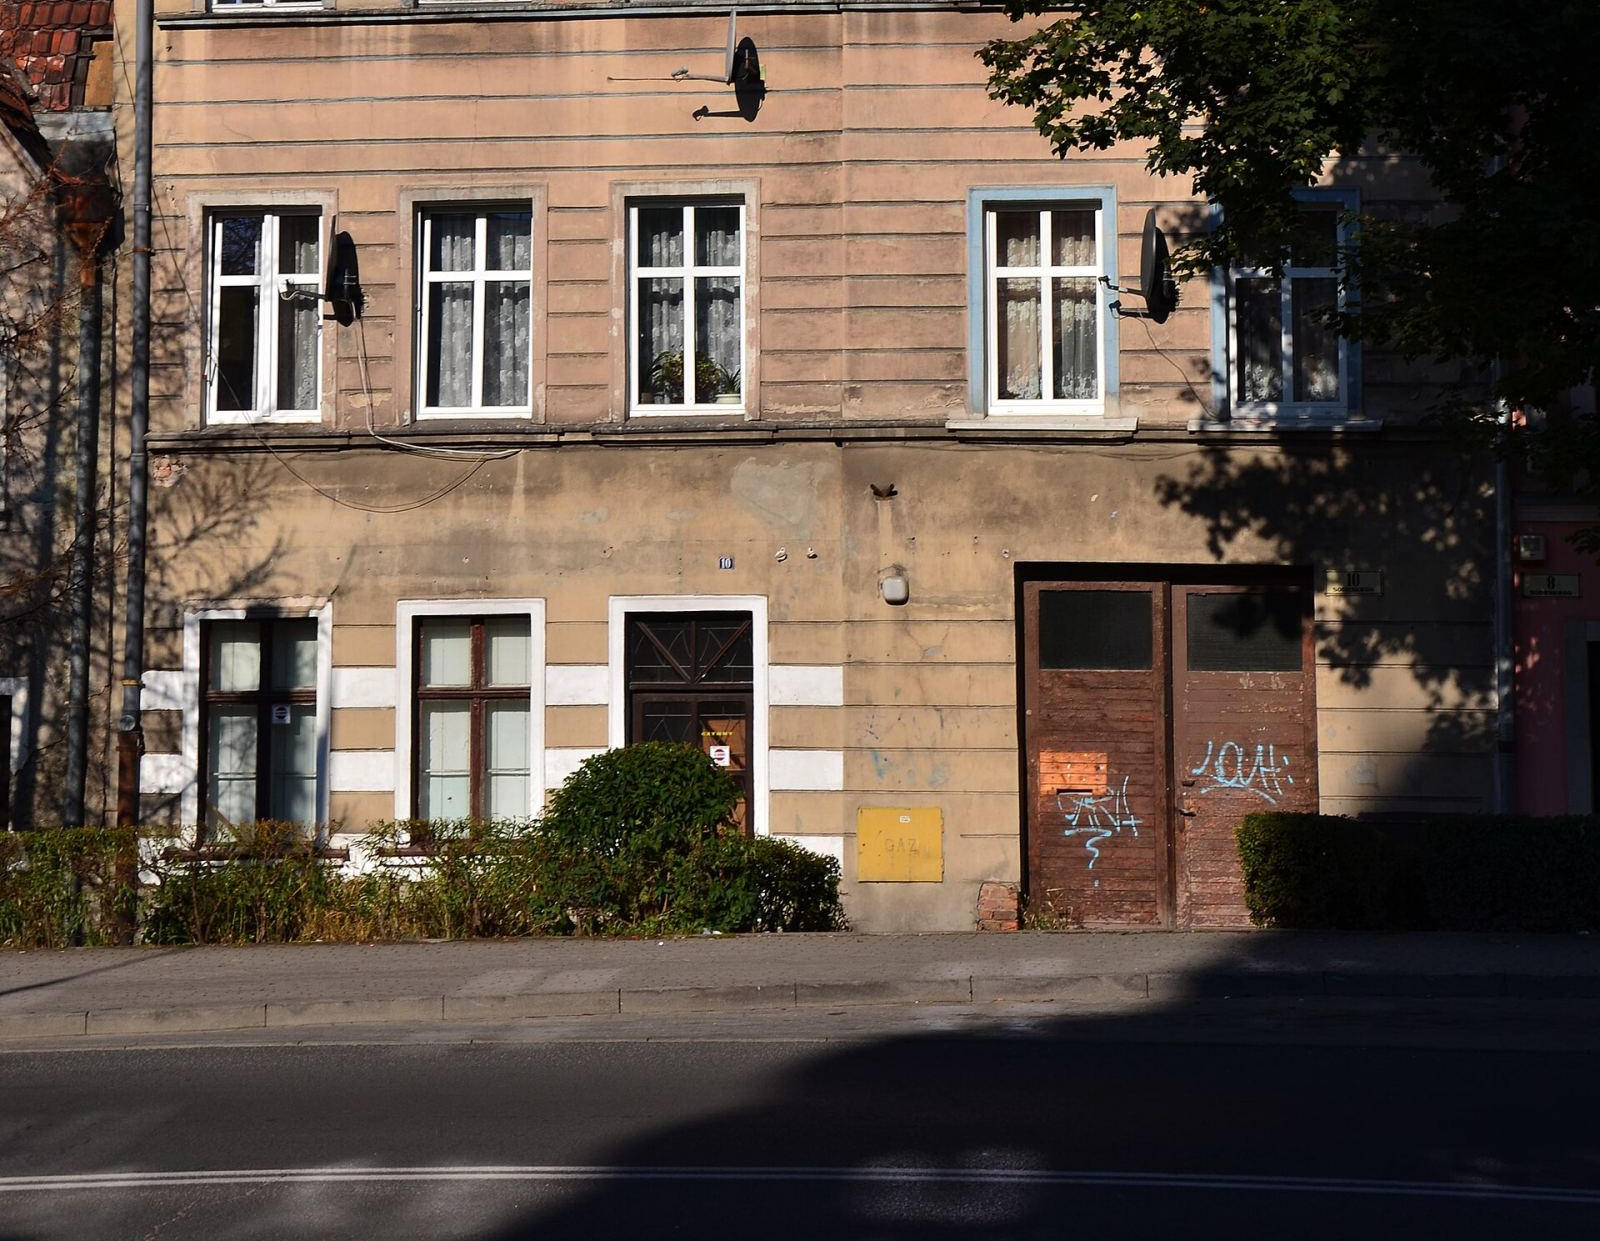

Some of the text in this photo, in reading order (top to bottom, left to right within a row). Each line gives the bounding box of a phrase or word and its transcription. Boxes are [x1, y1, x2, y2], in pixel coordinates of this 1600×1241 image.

[720, 556, 732, 569] 10
[1347, 573, 1361, 587] 10
[1547, 575, 1556, 590] 8
[884, 837, 919, 854] GAZ
